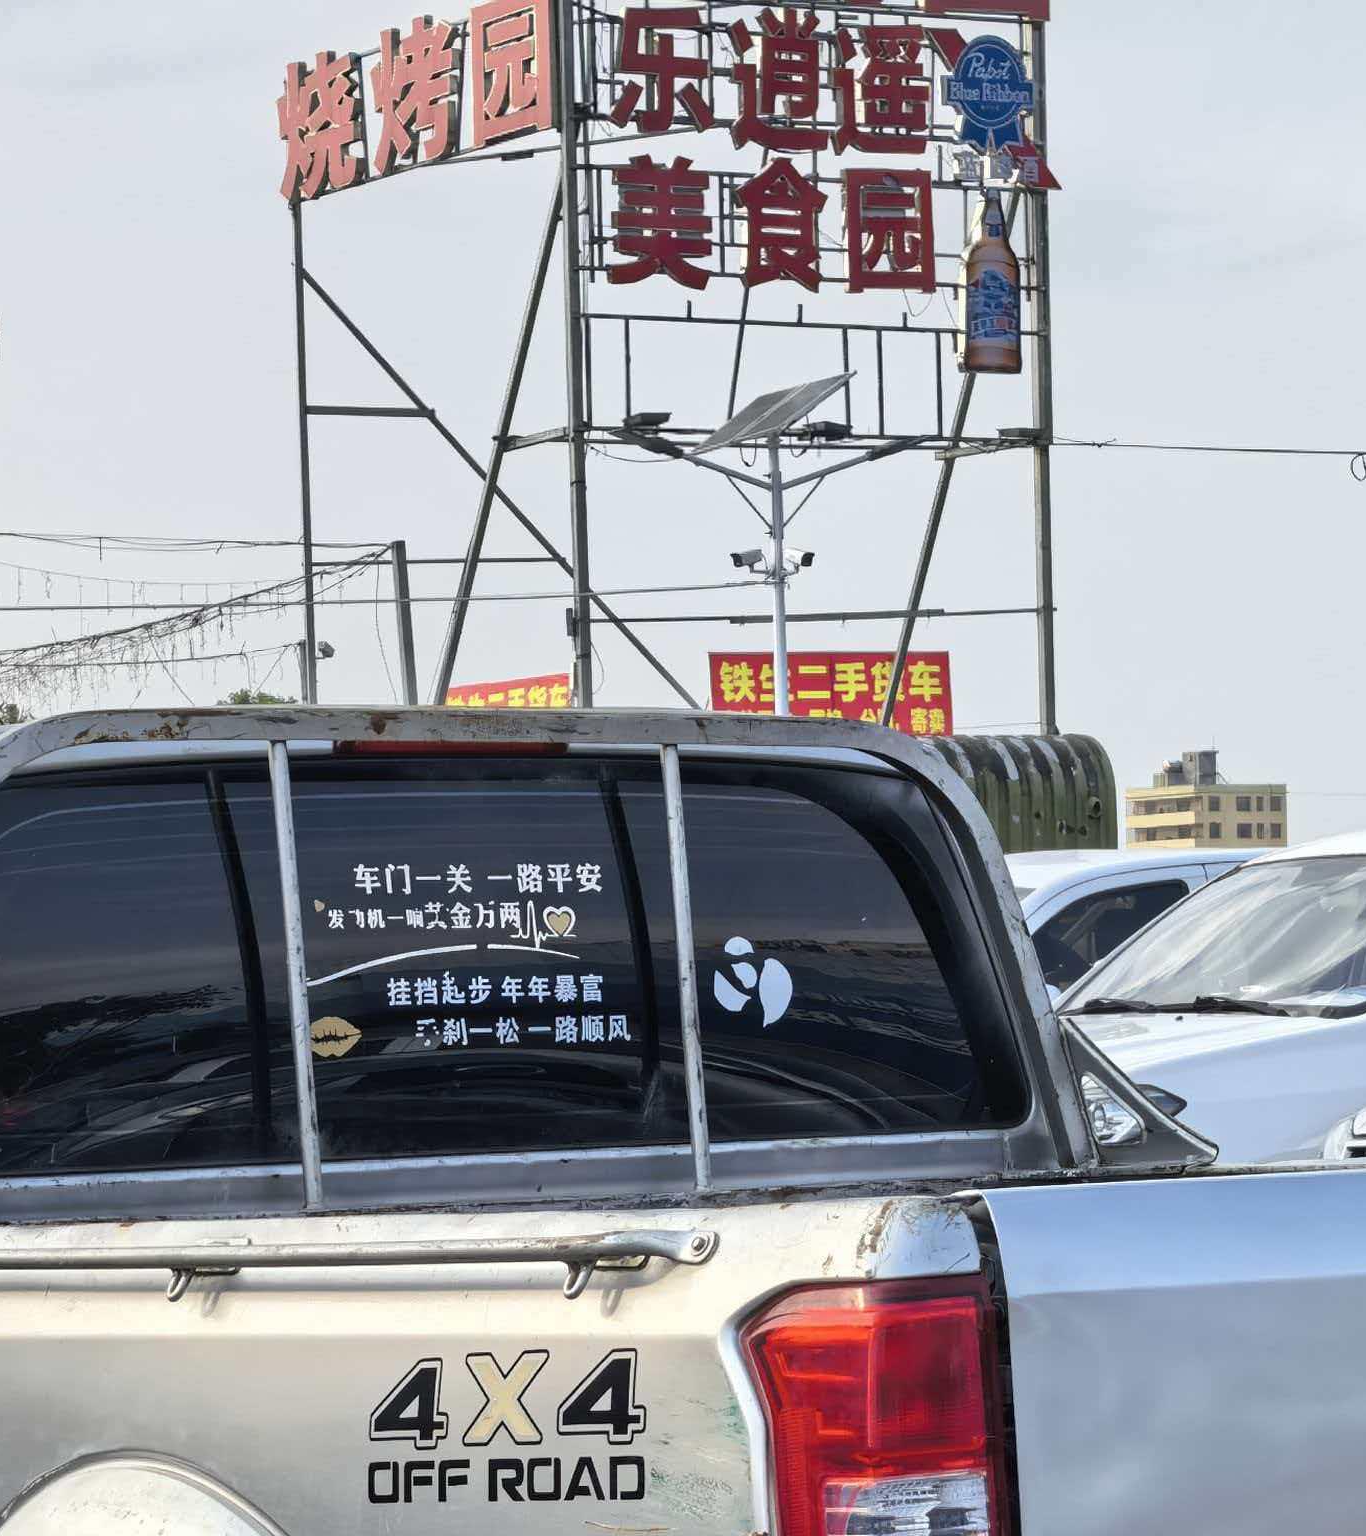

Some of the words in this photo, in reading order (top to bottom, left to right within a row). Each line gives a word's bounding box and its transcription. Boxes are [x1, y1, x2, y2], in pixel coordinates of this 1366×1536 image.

[276, 0, 557, 200] 烧烤园
[610, 7, 929, 155] 乐逍遥
[949, 81, 981, 101] Blue
[982, 82, 1030, 103] Ribbon
[967, 51, 1011, 80] Pabst
[608, 155, 935, 293] 美食园
[353, 863, 473, 894] 车门一关
[487, 863, 603, 893] 一路平安
[369, 1348, 647, 1450] 4X4
[368, 1459, 471, 1504] OFF
[488, 1455, 646, 1502] ROAD
